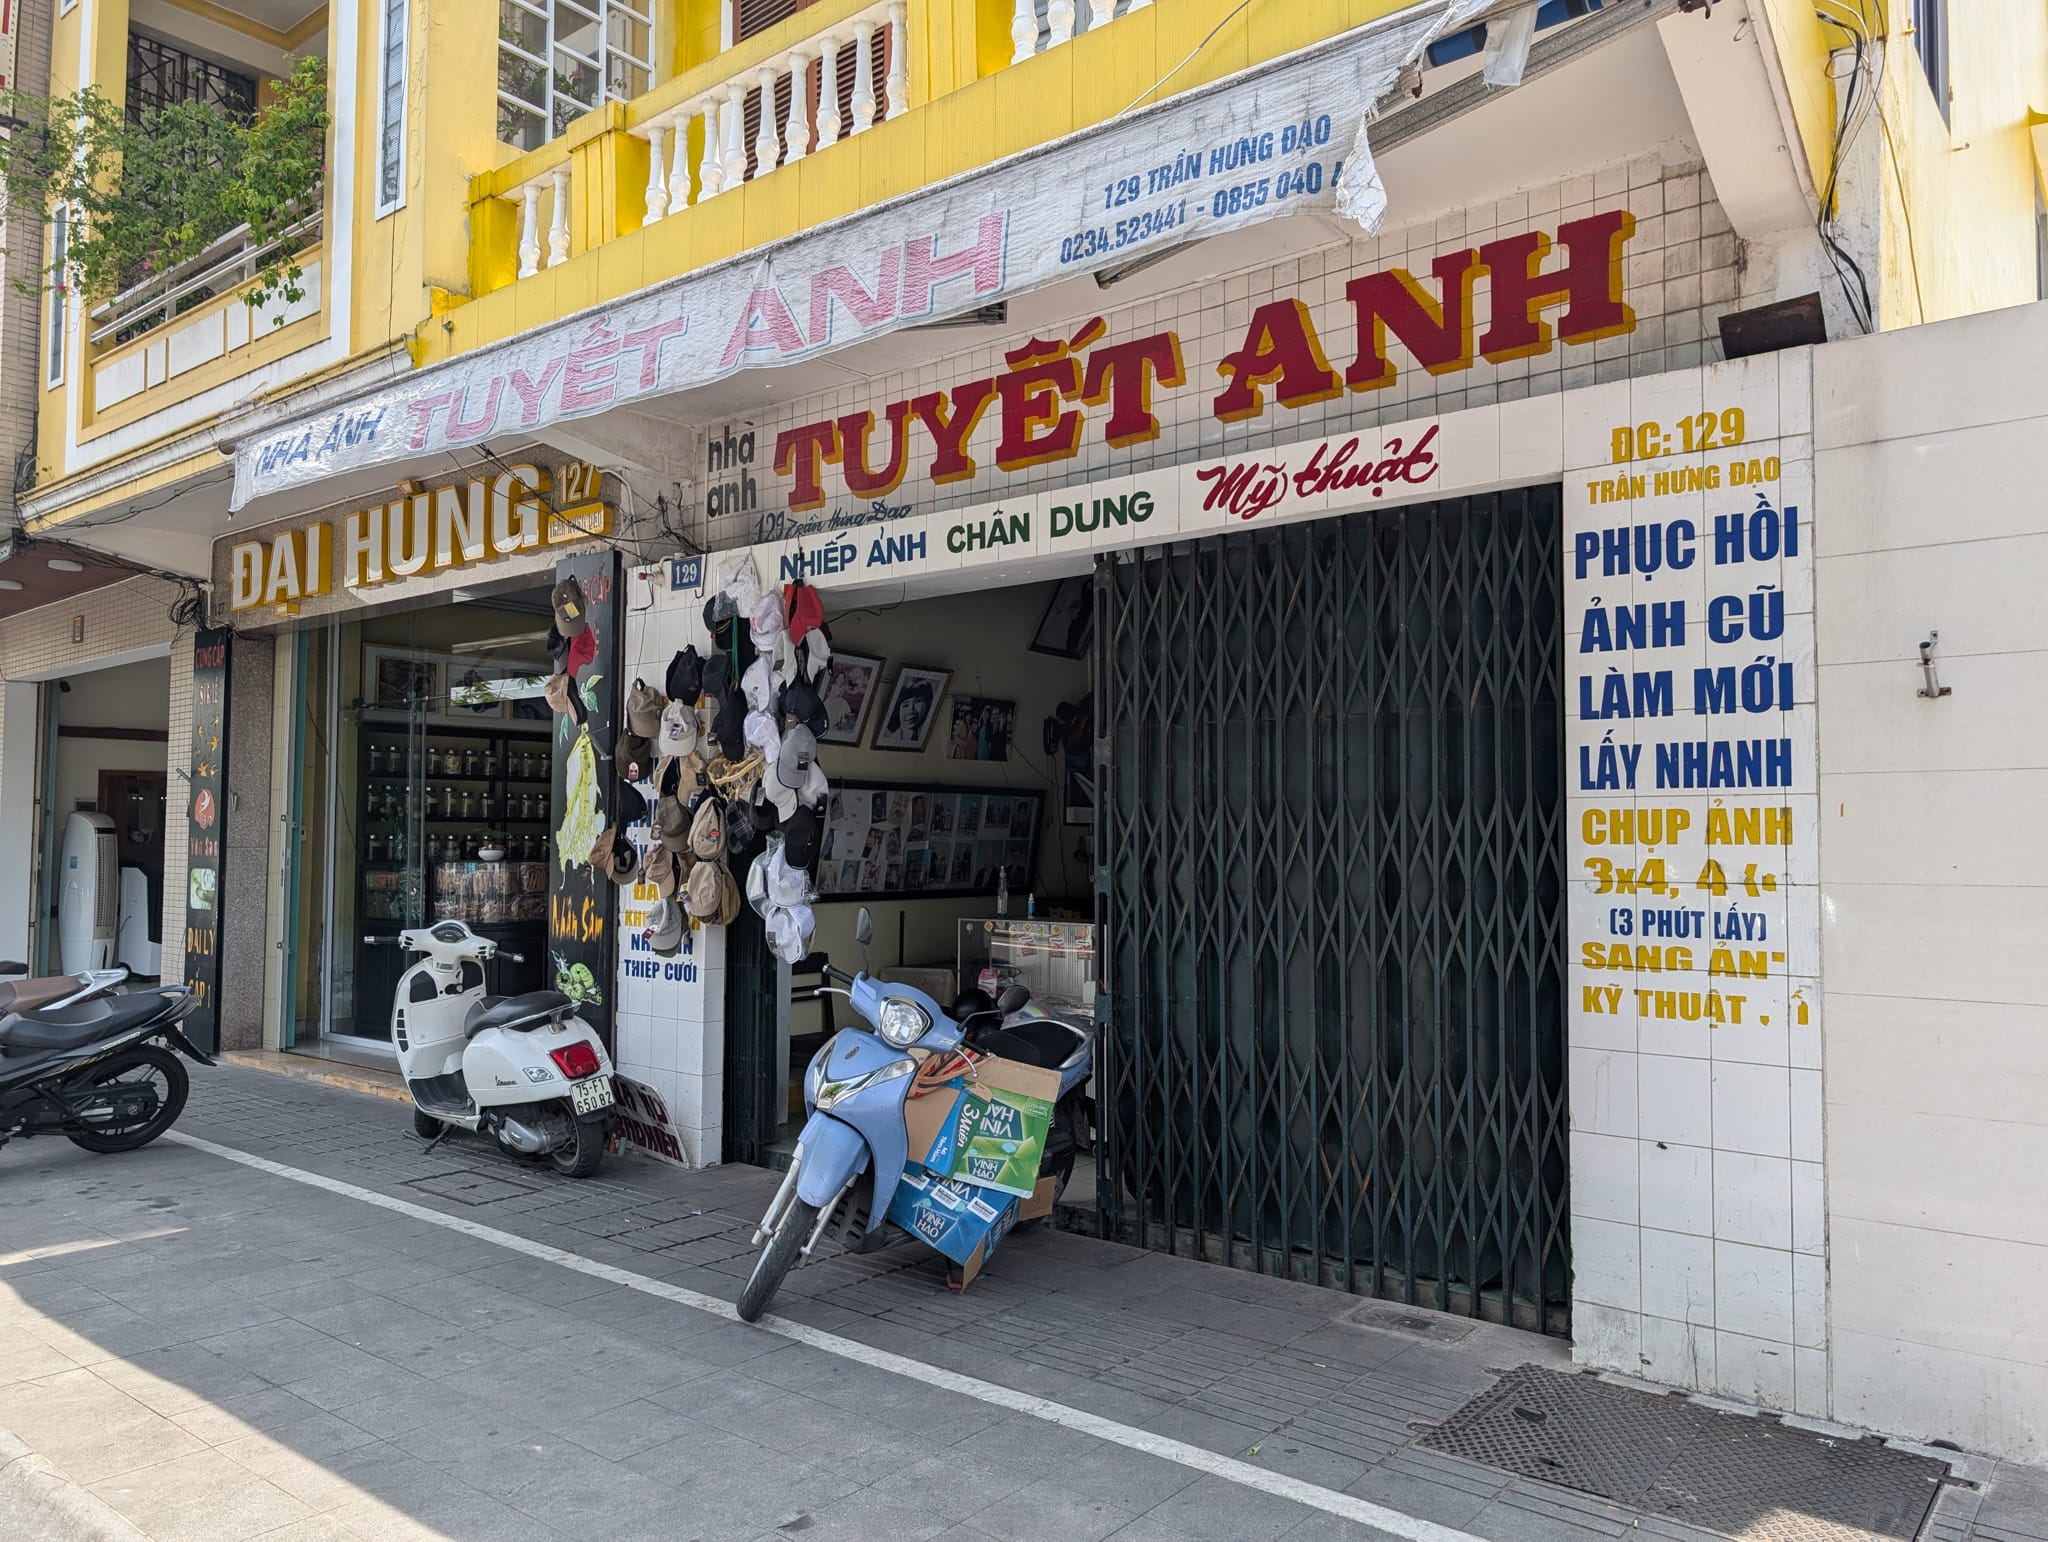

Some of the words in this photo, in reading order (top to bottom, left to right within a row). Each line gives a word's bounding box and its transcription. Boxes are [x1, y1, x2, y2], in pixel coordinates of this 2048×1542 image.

[1104, 175, 1141, 209] 129
[1147, 148, 1202, 195] TRẦN
[1208, 131, 1274, 176] HƯNG
[1280, 114, 1331, 155] ĐẠO
[1060, 199, 1186, 265] 0234.523441
[1212, 178, 1271, 218] 0855
[1275, 162, 1322, 199] 040
[716, 208, 1010, 374] ANH
[773, 316, 1186, 513] TUYẾT
[1213, 209, 1636, 424] ANH
[708, 421, 755, 472] nhà
[1196, 461, 1288, 520] Mỹ
[1293, 424, 1439, 498] thuật
[1654, 464, 1720, 496] HƯNG
[1729, 456, 1780, 488] ĐẠO
[558, 462, 601, 504] 127
[230, 522, 332, 616] ĐẠI
[344, 464, 552, 588] HÙNG
[753, 510, 784, 545] 129
[780, 531, 858, 581] NHIẾP
[866, 526, 927, 568] ẢNH
[946, 508, 1031, 554] CHÂN
[1050, 491, 1155, 538] DUNG
[1575, 519, 1696, 582] PHỤC
[1714, 493, 1798, 565] HỒI
[675, 562, 698, 584] 129
[1579, 596, 1686, 653] ẢNH
[1708, 584, 1785, 644] CŨ
[1579, 666, 1674, 720] LÀM
[1694, 655, 1794, 715] MỚI
[1579, 729, 1642, 790] LẤY
[1655, 738, 1793, 789] NHANH
[1581, 808, 1691, 853] CHỤP
[1704, 798, 1794, 846] ẢNH
[1609, 908, 1634, 936] (3
[1642, 906, 1705, 938] PHÚT
[1714, 902, 1767, 942] LẤY)
[624, 957, 660, 983] THIỆP
[664, 959, 698, 983] CƯỚI
[1581, 942, 1693, 972] SANG
[1708, 941, 1785, 979] ẢN
[1582, 983, 1624, 1015] KỸ
[1633, 988, 1747, 1029] THUẬT
